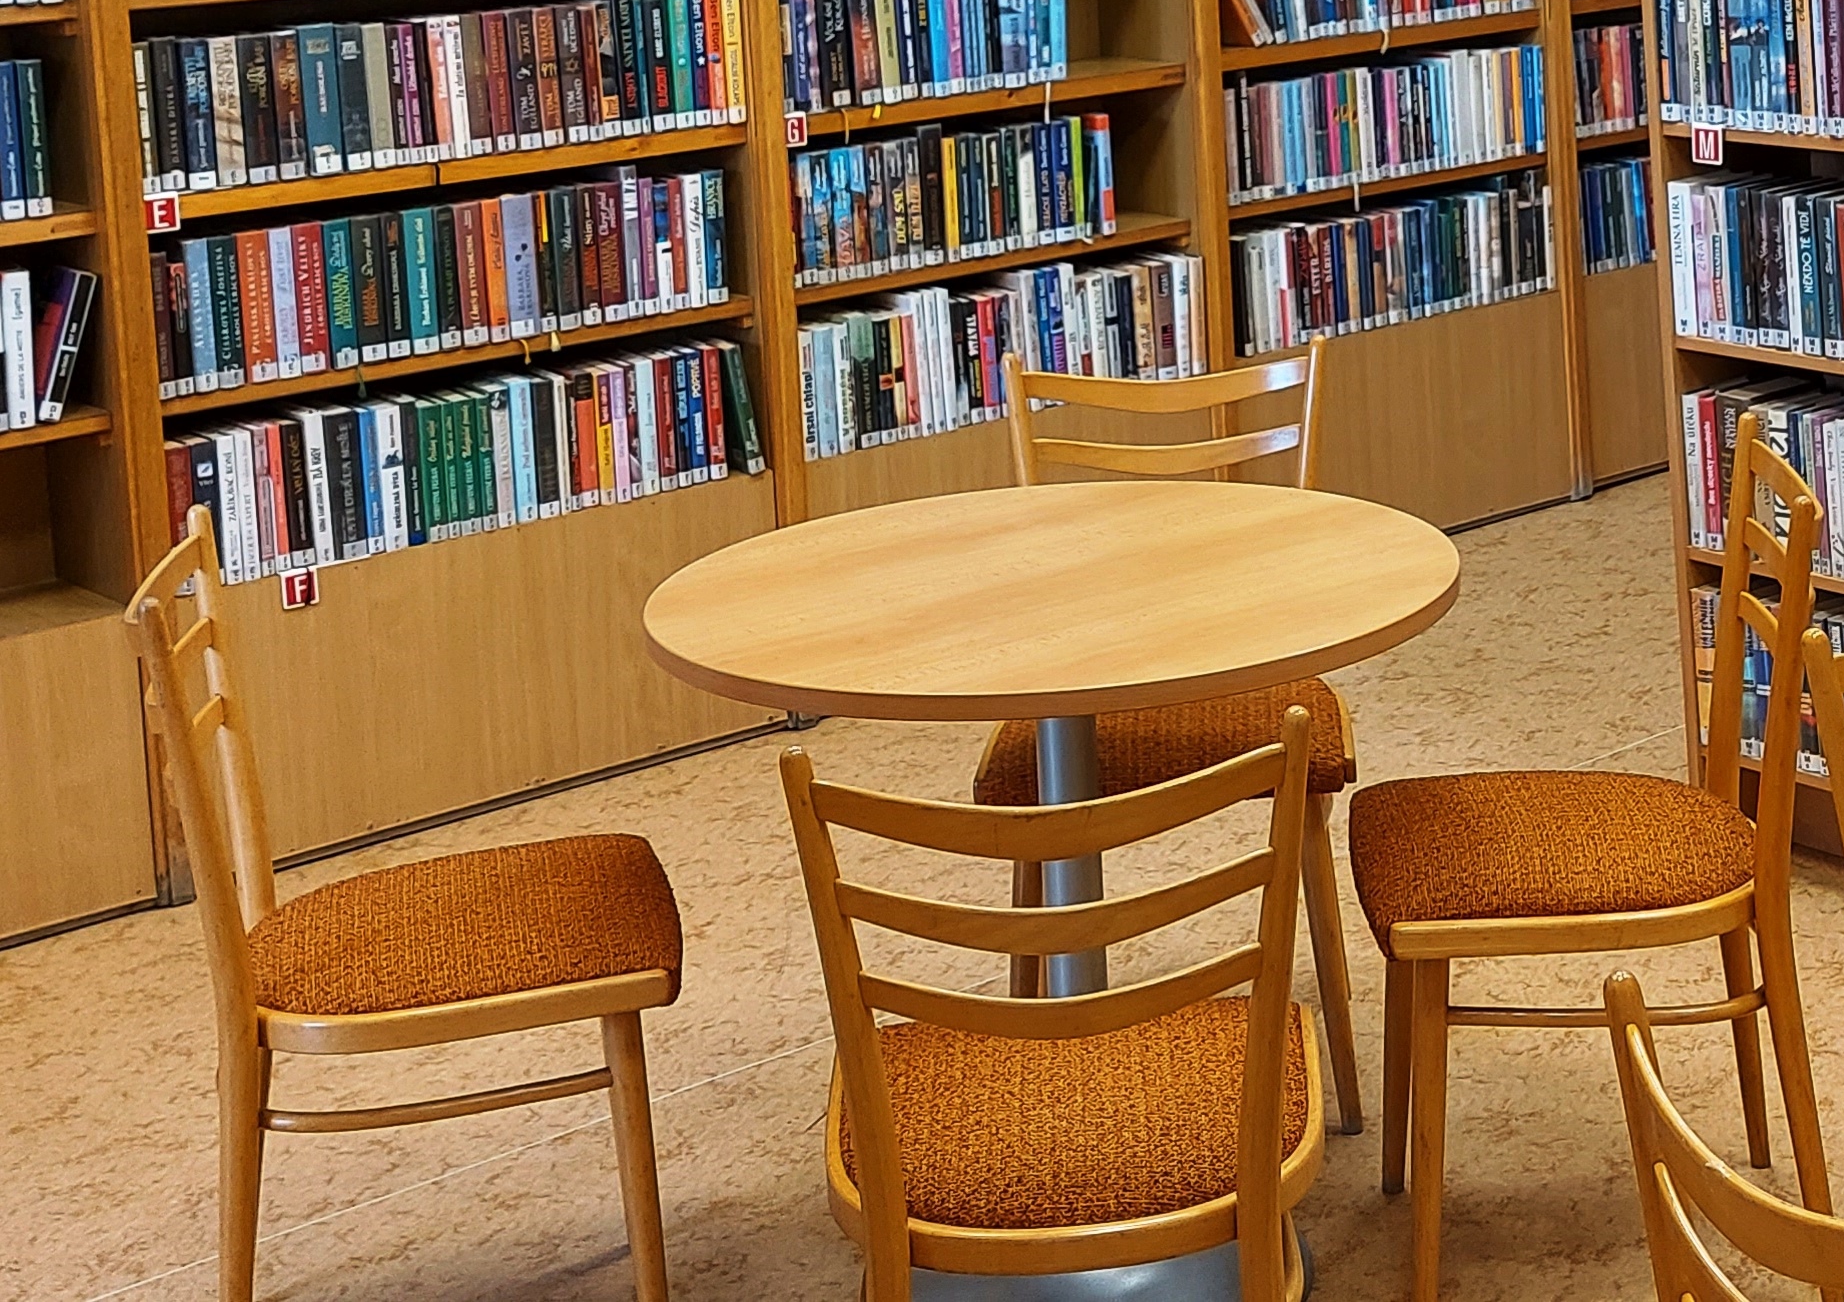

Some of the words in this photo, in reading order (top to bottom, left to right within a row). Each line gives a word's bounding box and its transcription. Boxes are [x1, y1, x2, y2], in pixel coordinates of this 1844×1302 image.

[694, 22, 703, 53] Elton
[711, 22, 719, 51] Elton
[727, 15, 735, 36] Elton
[521, 96, 530, 120] TOM
[567, 90, 575, 113] TOM
[787, 119, 799, 143] G
[1698, 130, 1715, 160] M
[153, 200, 170, 228] E
[294, 574, 308, 603] F
